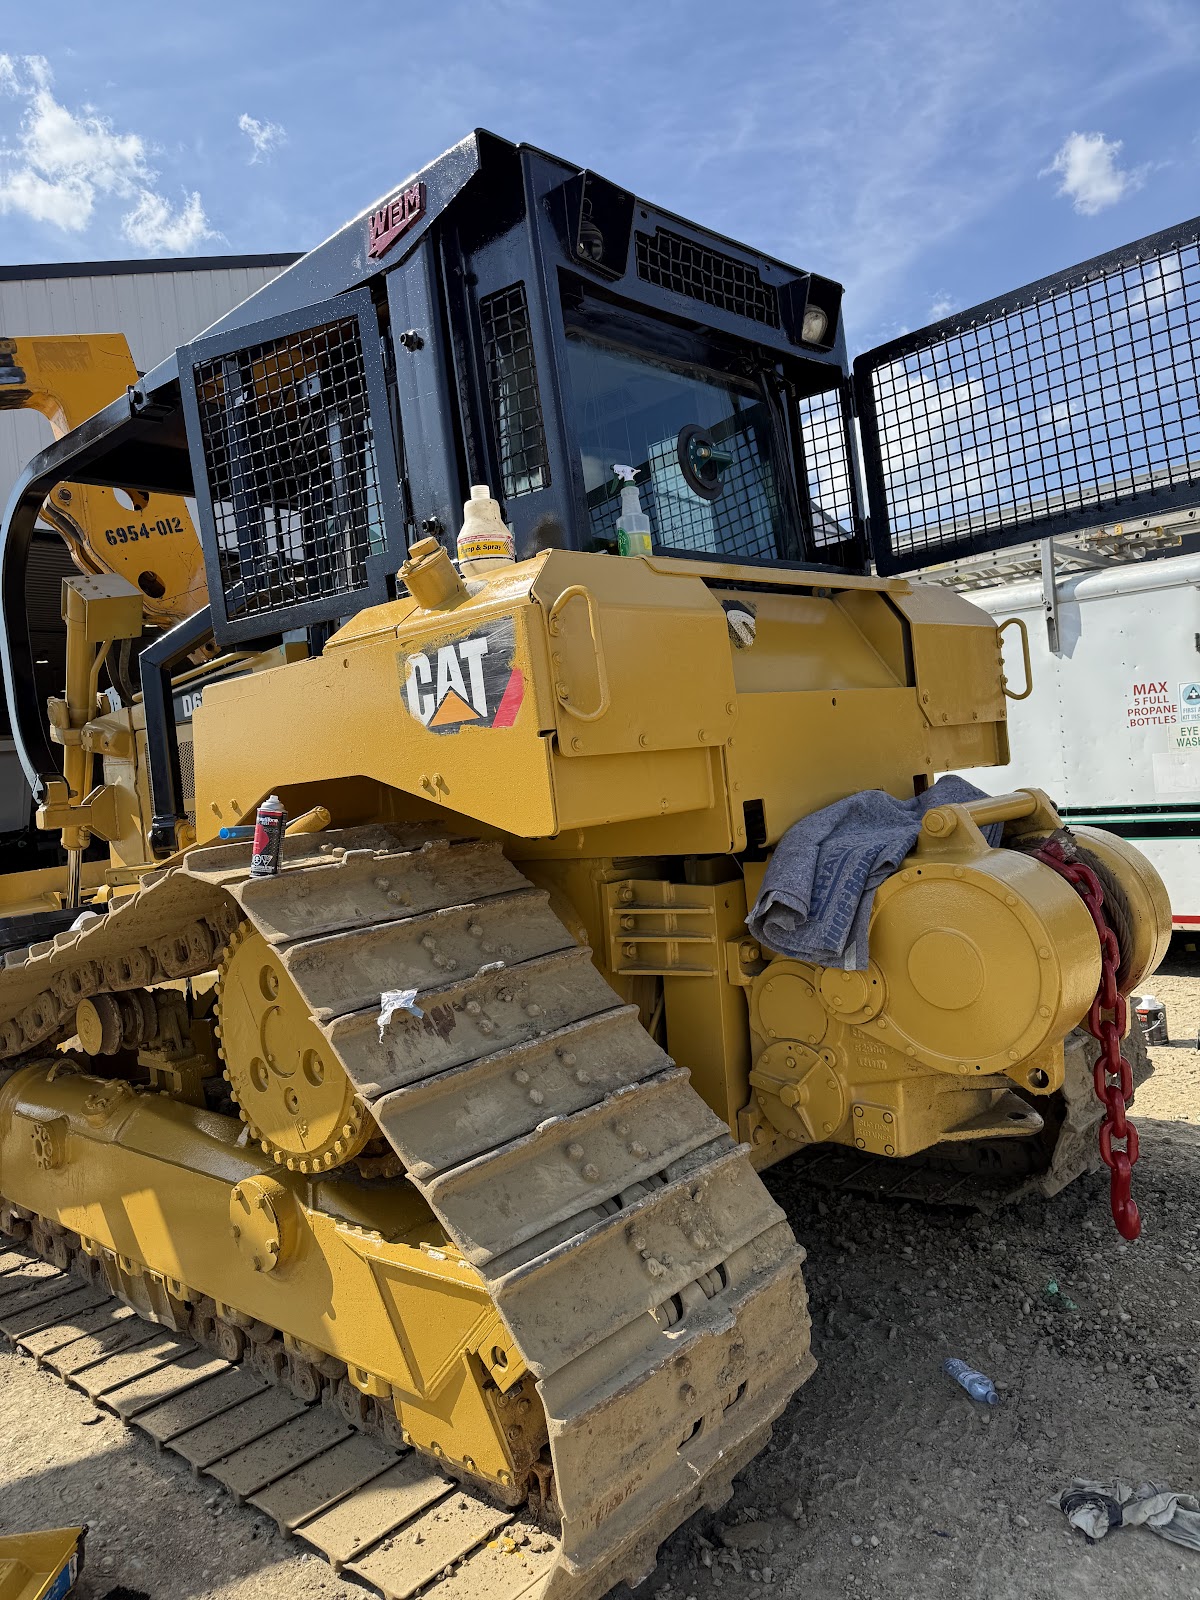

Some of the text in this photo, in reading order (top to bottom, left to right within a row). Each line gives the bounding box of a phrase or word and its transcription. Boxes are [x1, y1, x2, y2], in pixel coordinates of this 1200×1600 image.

[368, 181, 421, 241] WBM
[105, 517, 184, 546] 6954-012
[405, 637, 488, 727] CAT
[1133, 681, 1168, 696] MAX
[182, 691, 203, 717] D6
[1134, 695, 1169, 706] 5 FULL
[1127, 704, 1178, 717] PROPANE
[1130, 715, 1177, 727] BOTTLES
[1180, 726, 1199, 736] EYE
